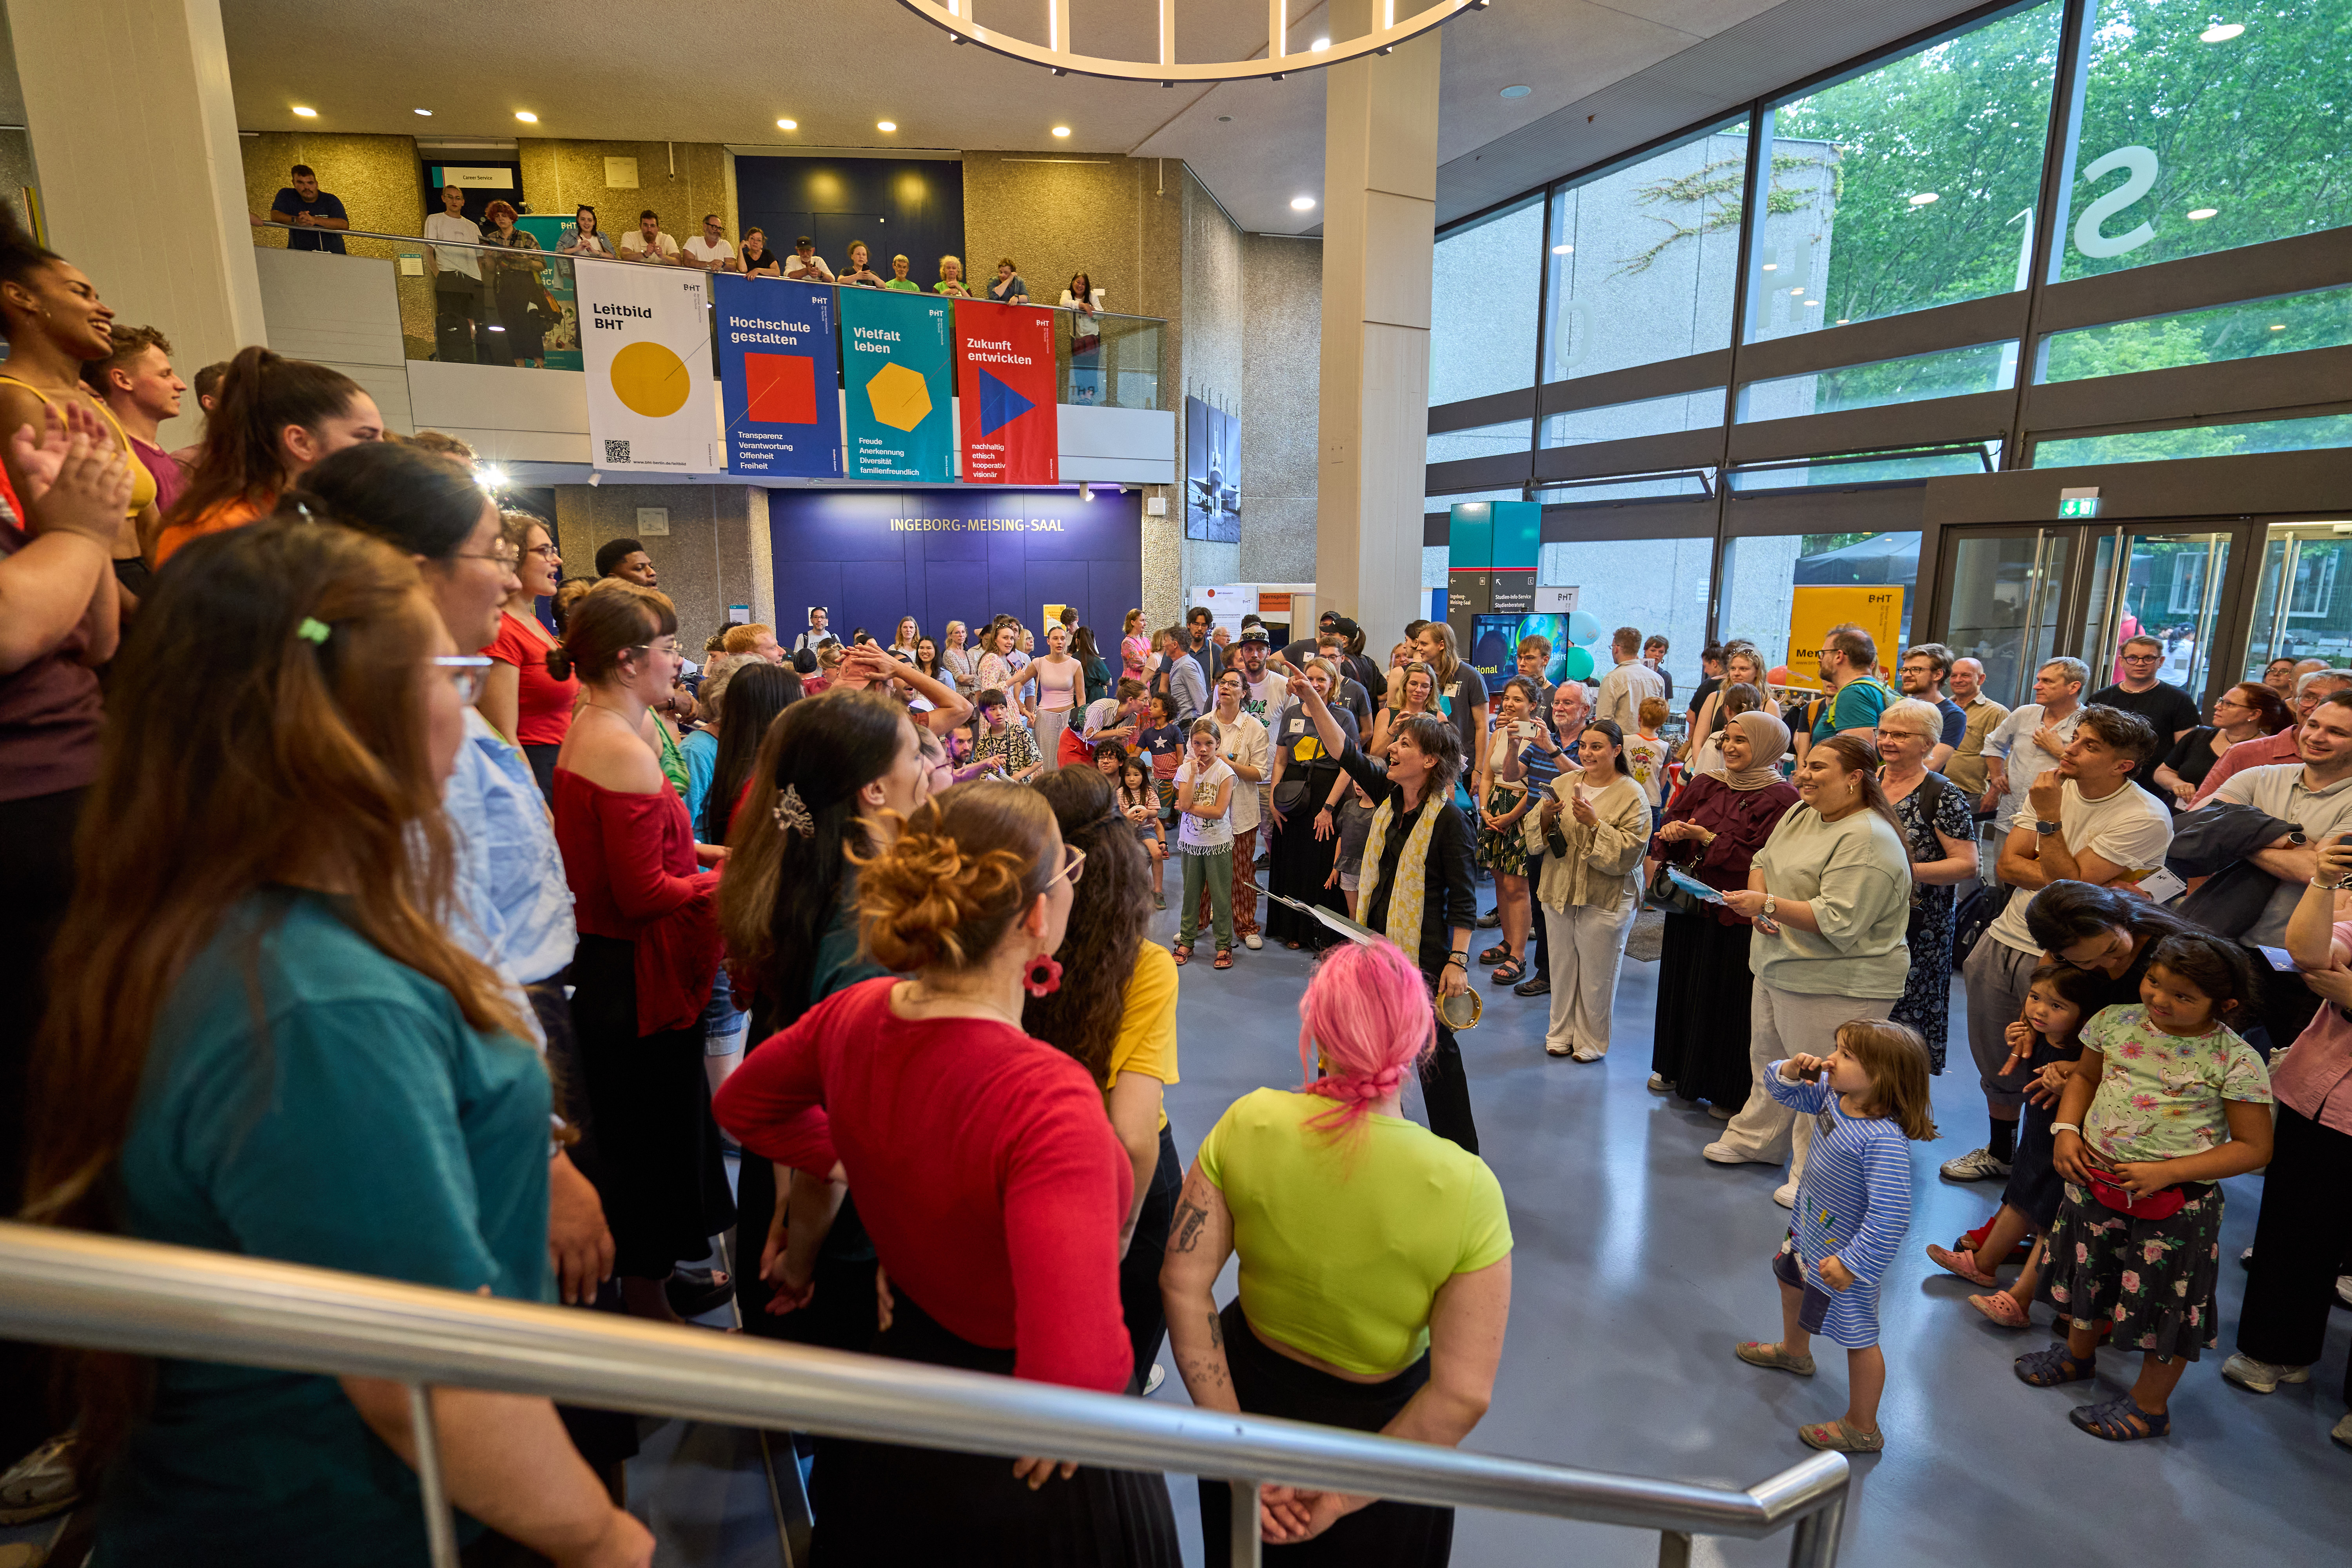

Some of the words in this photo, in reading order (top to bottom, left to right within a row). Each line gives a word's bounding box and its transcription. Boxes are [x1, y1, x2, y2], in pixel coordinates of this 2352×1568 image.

[683, 283, 700, 292] BHT
[812, 296, 828, 305] BHT
[593, 303, 652, 318] Leitbild
[595, 318, 623, 330] BHT
[730, 316, 810, 333] Hochschule
[731, 332, 797, 345] gestalten
[853, 327, 901, 341] Vielfalt
[855, 341, 890, 354] leben
[967, 338, 1011, 351] Zukunft
[968, 352, 1032, 365] entwicklen
[738, 431, 783, 440] Transparenz
[739, 442, 793, 452] Verantwortung
[859, 447, 904, 457] Anerkennung
[860, 466, 919, 475] familienfreundlich
[891, 519, 1065, 531] INGEBORG-MEISING-SAAL
[1868, 594, 1892, 603] BHT
